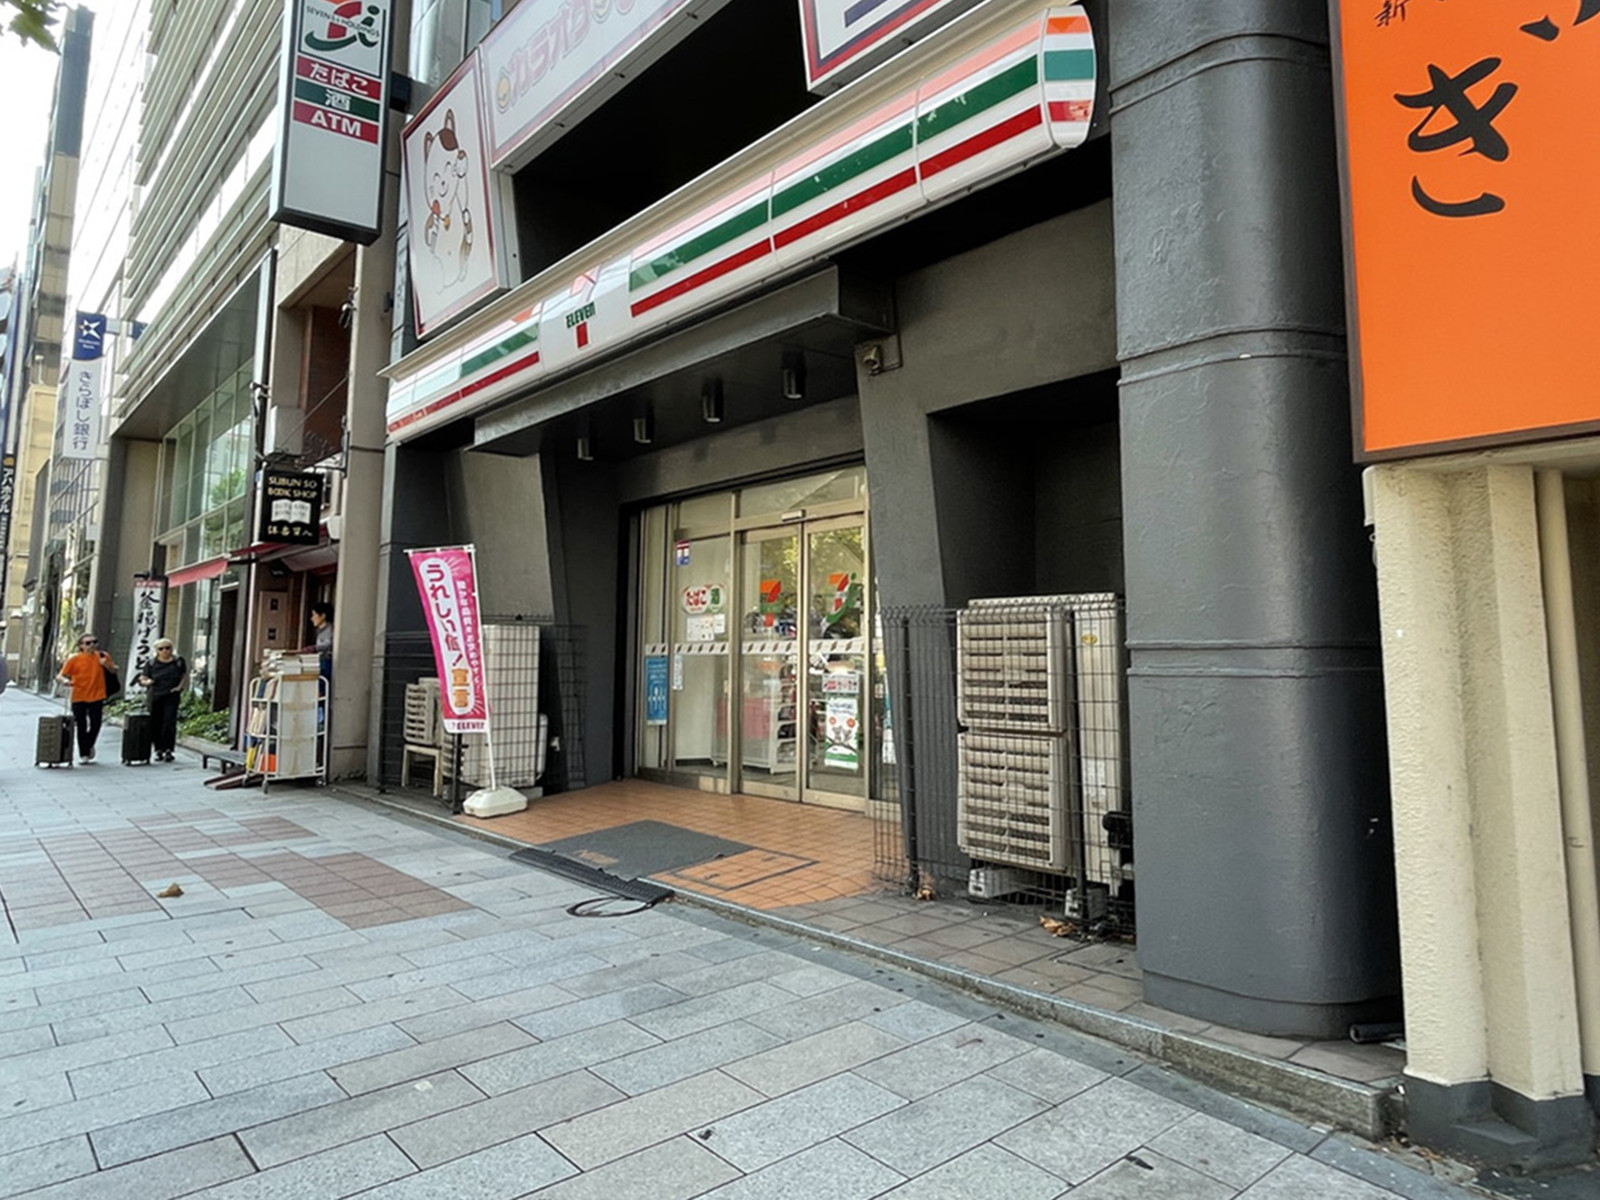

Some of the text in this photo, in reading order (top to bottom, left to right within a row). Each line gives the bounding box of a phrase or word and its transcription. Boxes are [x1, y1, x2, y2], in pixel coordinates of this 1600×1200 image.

[309, 62, 369, 95] たばこ
[324, 88, 351, 112] 酒
[311, 109, 362, 137] ATM
[72, 370, 93, 451] きらぼし銀行
[267, 487, 318, 499] BOOK SHOP
